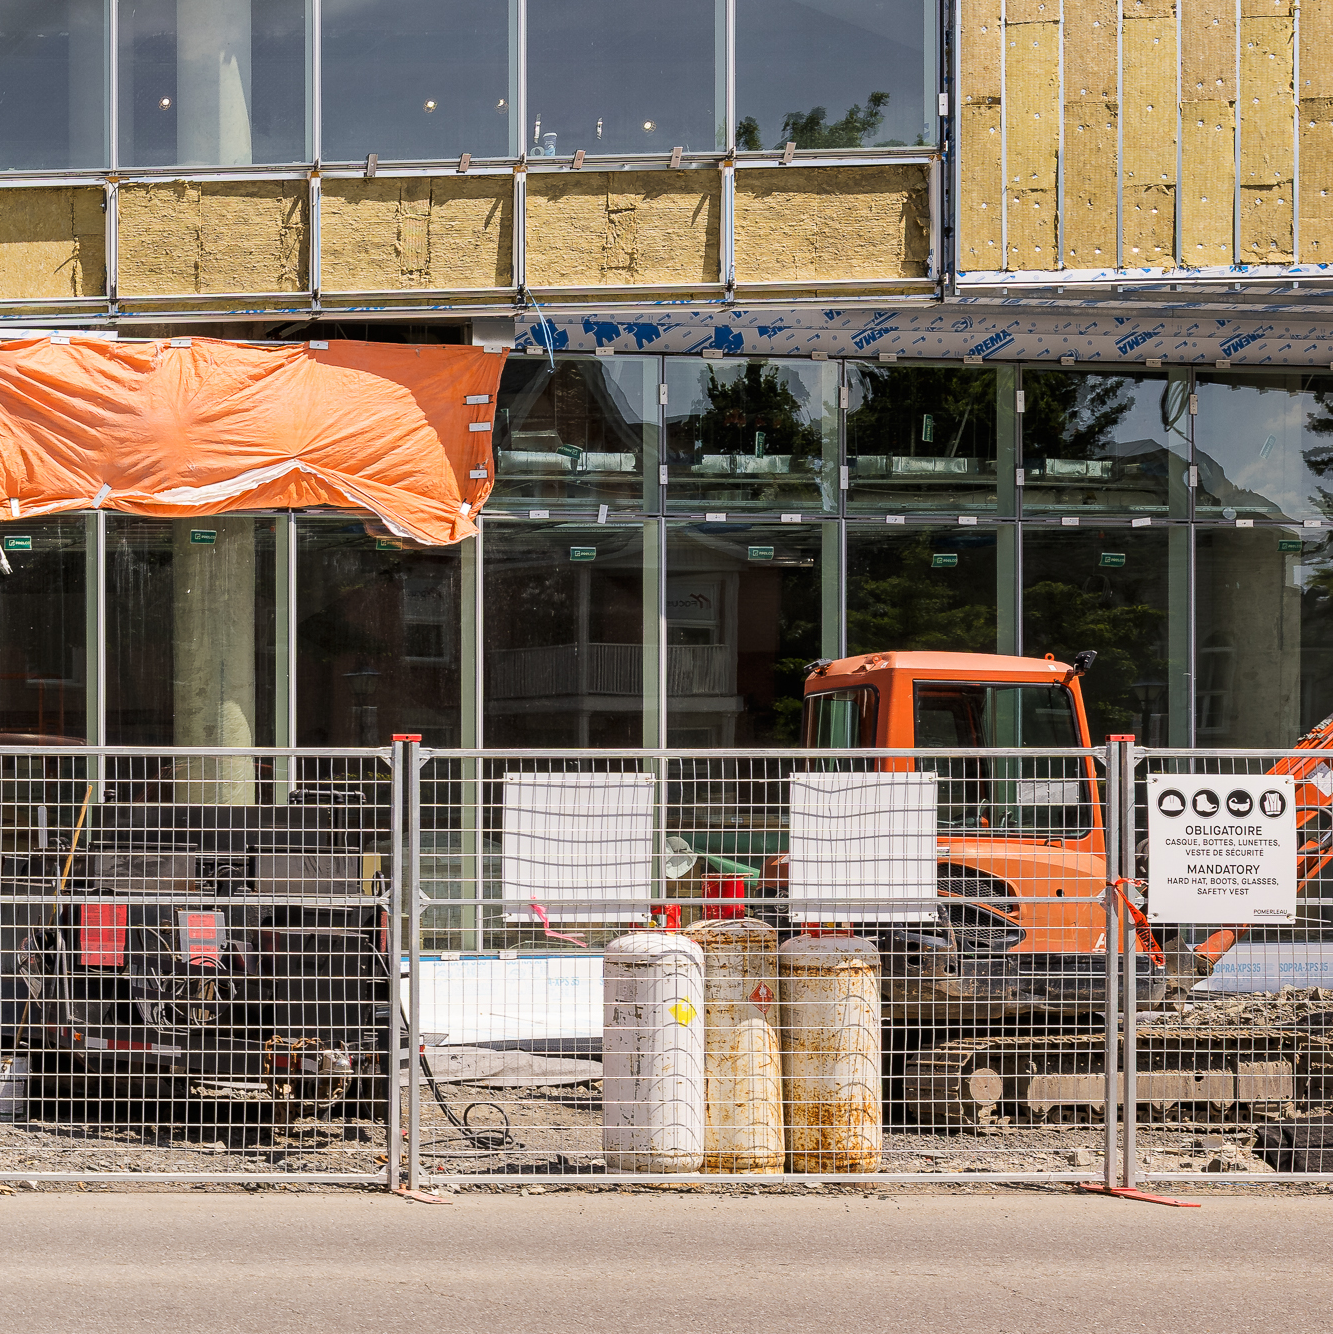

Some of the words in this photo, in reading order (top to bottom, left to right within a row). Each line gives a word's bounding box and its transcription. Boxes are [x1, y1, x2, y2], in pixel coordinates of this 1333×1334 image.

[1185, 825, 1263, 836] OBLIGATOIRE
[1165, 838, 1201, 847] CASQUE,
[1203, 838, 1236, 847] BOTTES,
[1238, 839, 1281, 847] LUNETTES,
[1185, 849, 1211, 857] VESTE
[1213, 849, 1223, 857] DE
[1225, 847, 1264, 857] SÉCURITÉ
[1187, 864, 1260, 875] MANDATORY
[1167, 877, 1189, 885] HARD
[1191, 877, 1208, 886] HAT,
[1210, 877, 1239, 885] BOOTS,
[1241, 877, 1279, 886] GLASSES,
[1252, 963, 1261, 973] 35
[1319, 962, 1329, 972] 35
